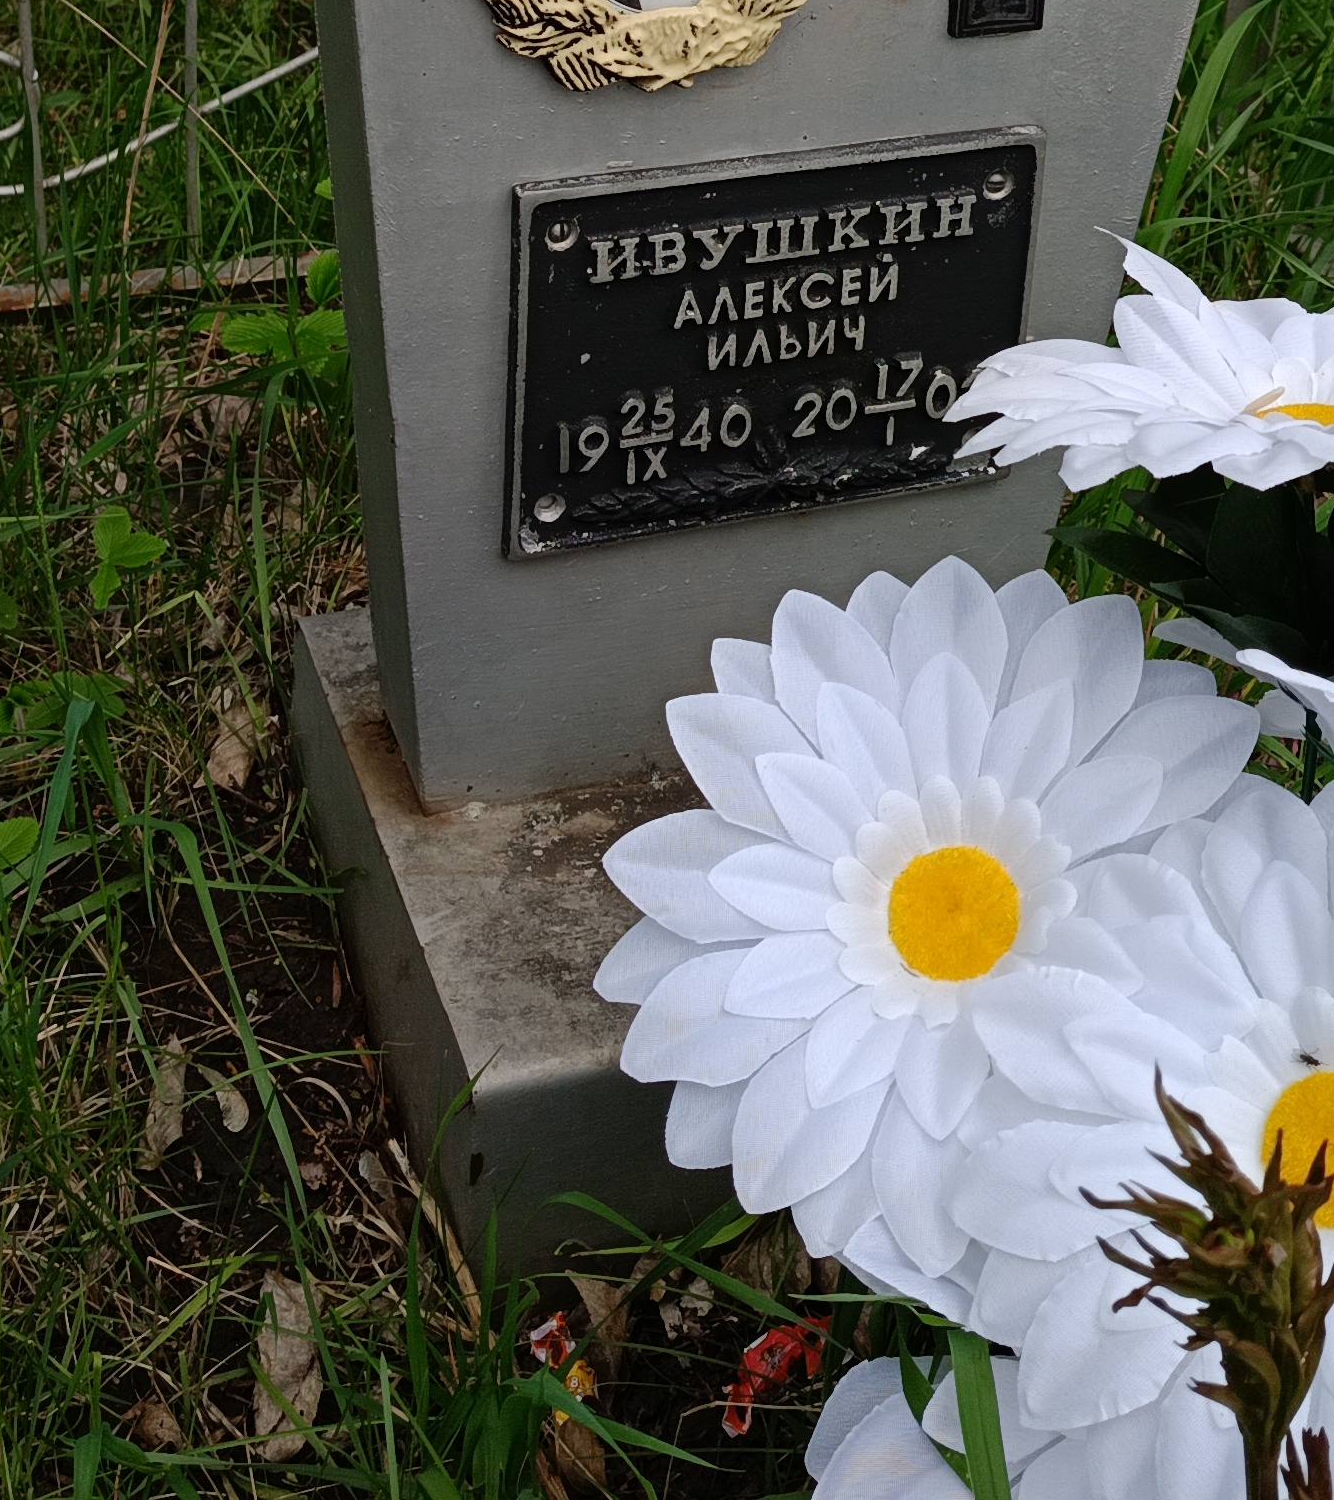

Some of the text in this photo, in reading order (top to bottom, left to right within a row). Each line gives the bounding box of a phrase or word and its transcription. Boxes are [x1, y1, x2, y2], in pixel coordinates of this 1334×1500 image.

[590, 195, 977, 283] ИВУШКИН
[674, 252, 899, 329] АЛЕКСЕЙ
[707, 315, 865, 370] ИЛЬИЧ
[559, 423, 609, 473] 19
[621, 394, 675, 437] 25
[680, 404, 752, 451] 40
[792, 386, 857, 438] 20
[878, 357, 923, 399] 17
